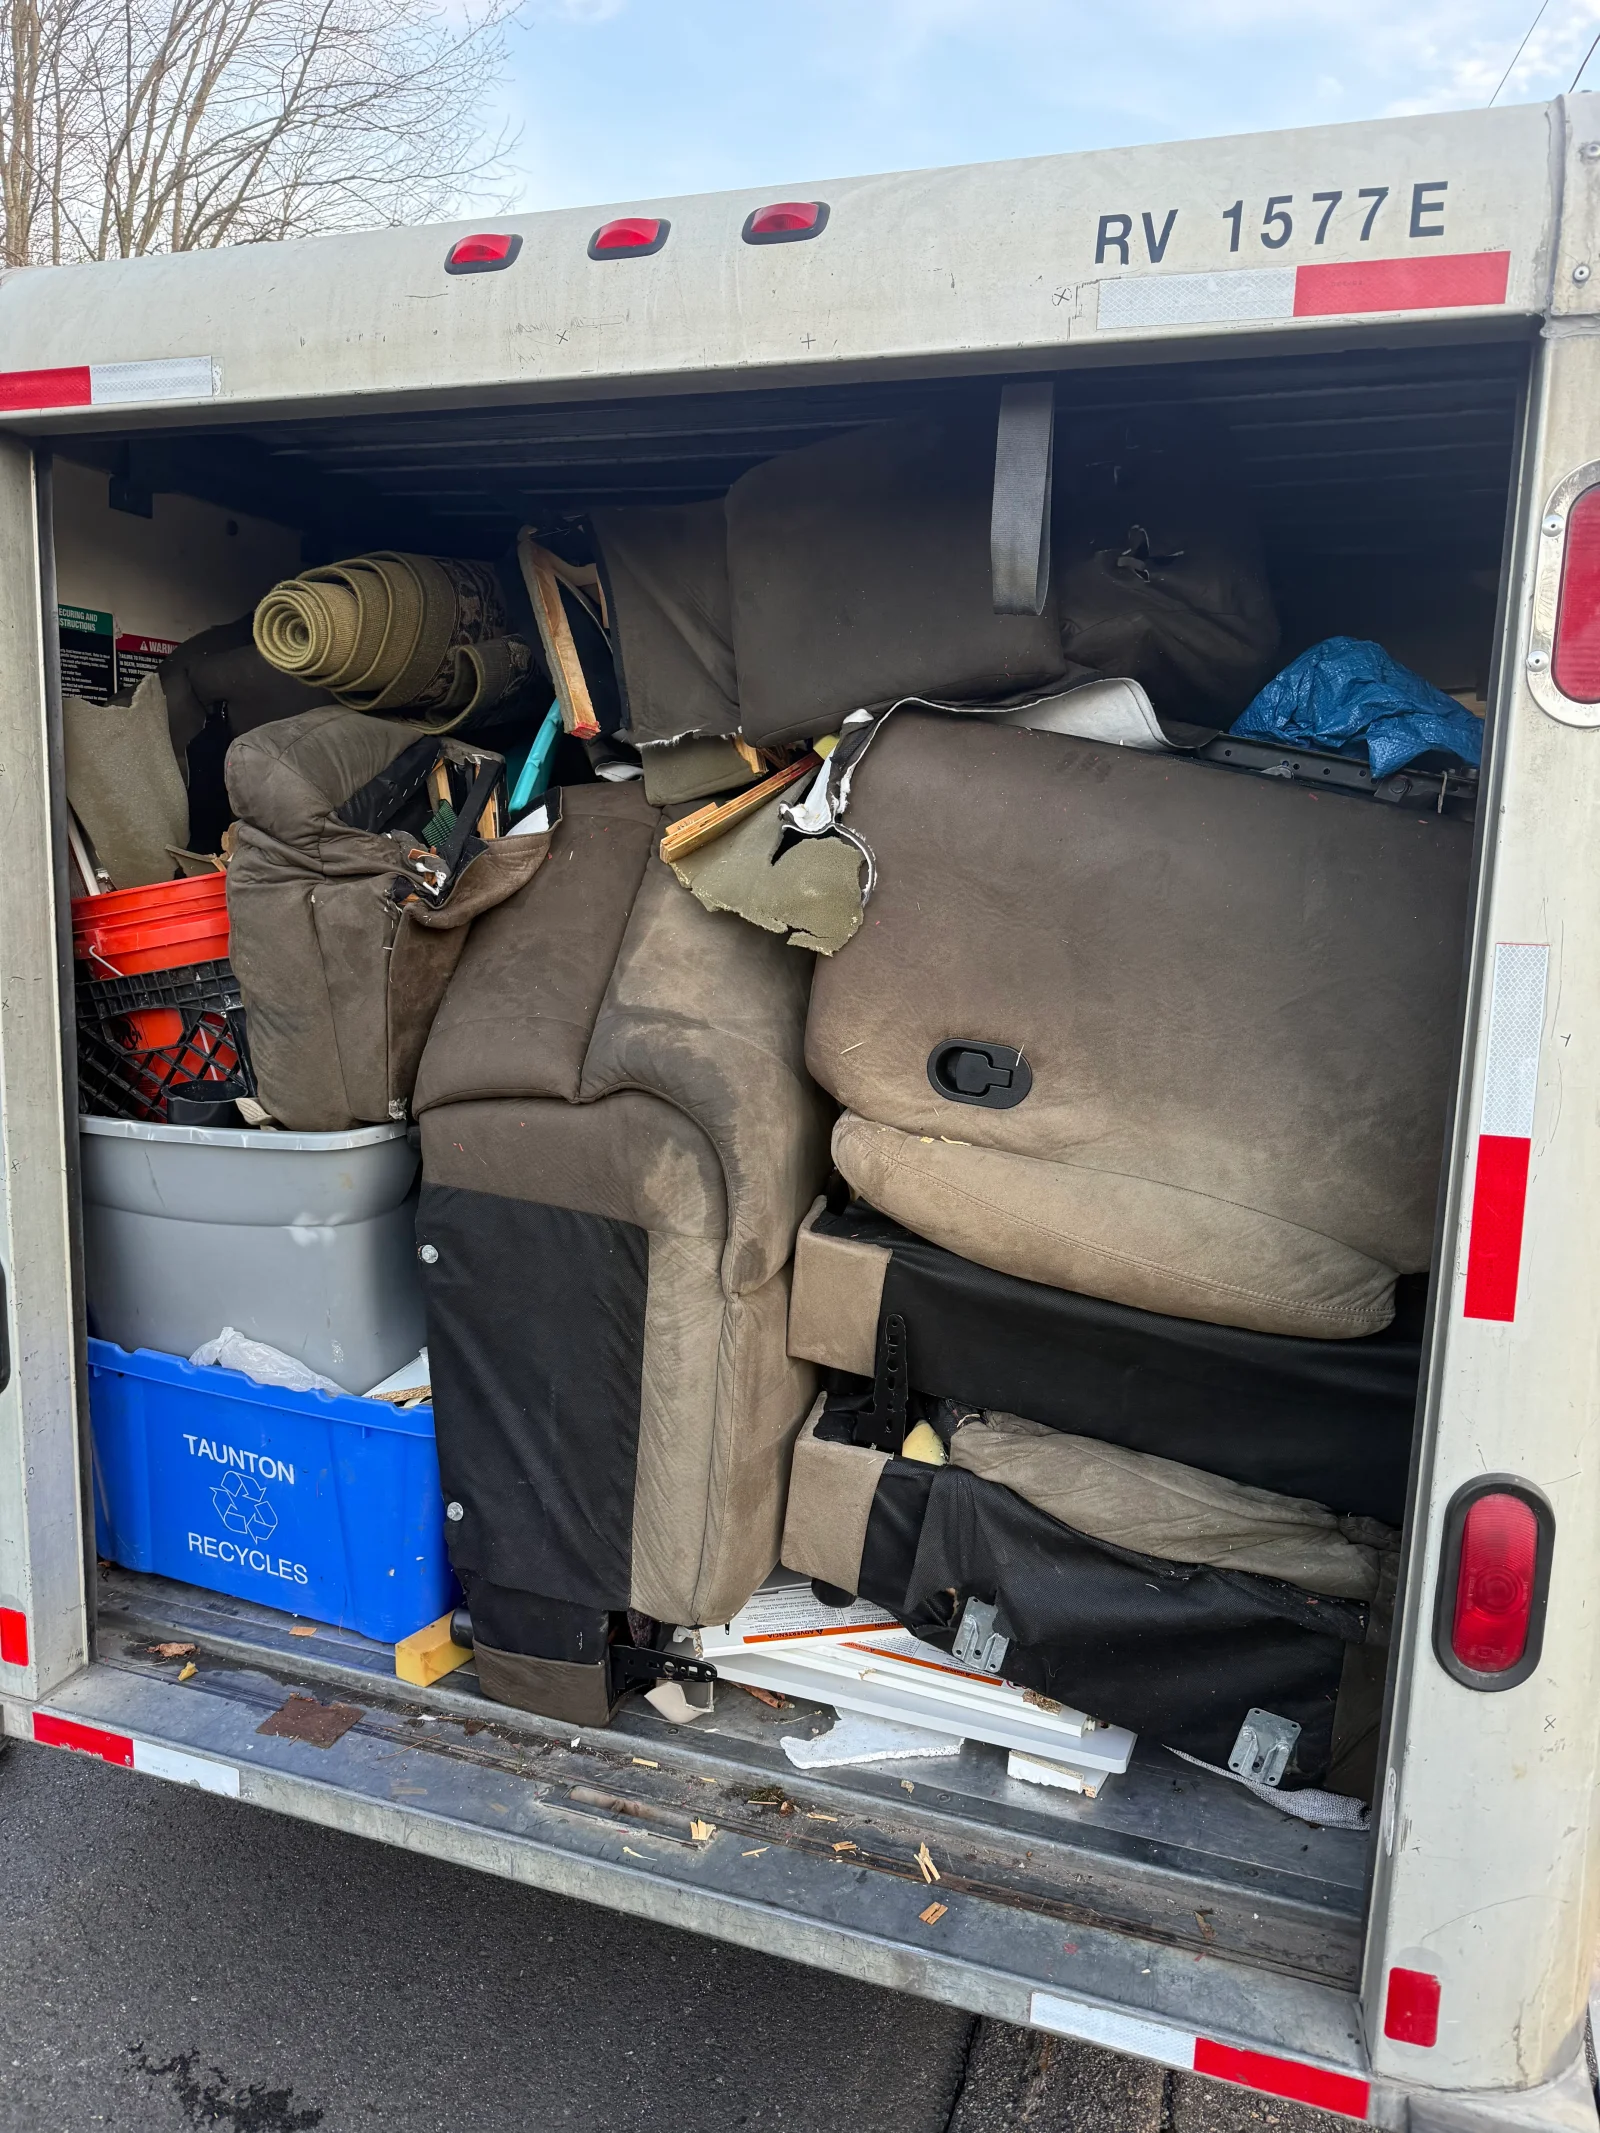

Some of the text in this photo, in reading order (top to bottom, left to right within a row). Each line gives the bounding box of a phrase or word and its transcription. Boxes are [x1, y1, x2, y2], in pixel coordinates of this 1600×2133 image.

[1094, 180, 1449, 266] RV 1577E
[58, 607, 98, 623] ECURING AND
[59, 617, 96, 632] STRUCTIONS
[182, 1433, 295, 1485] TAUNTON
[188, 1532, 309, 1585] RECYCLES
